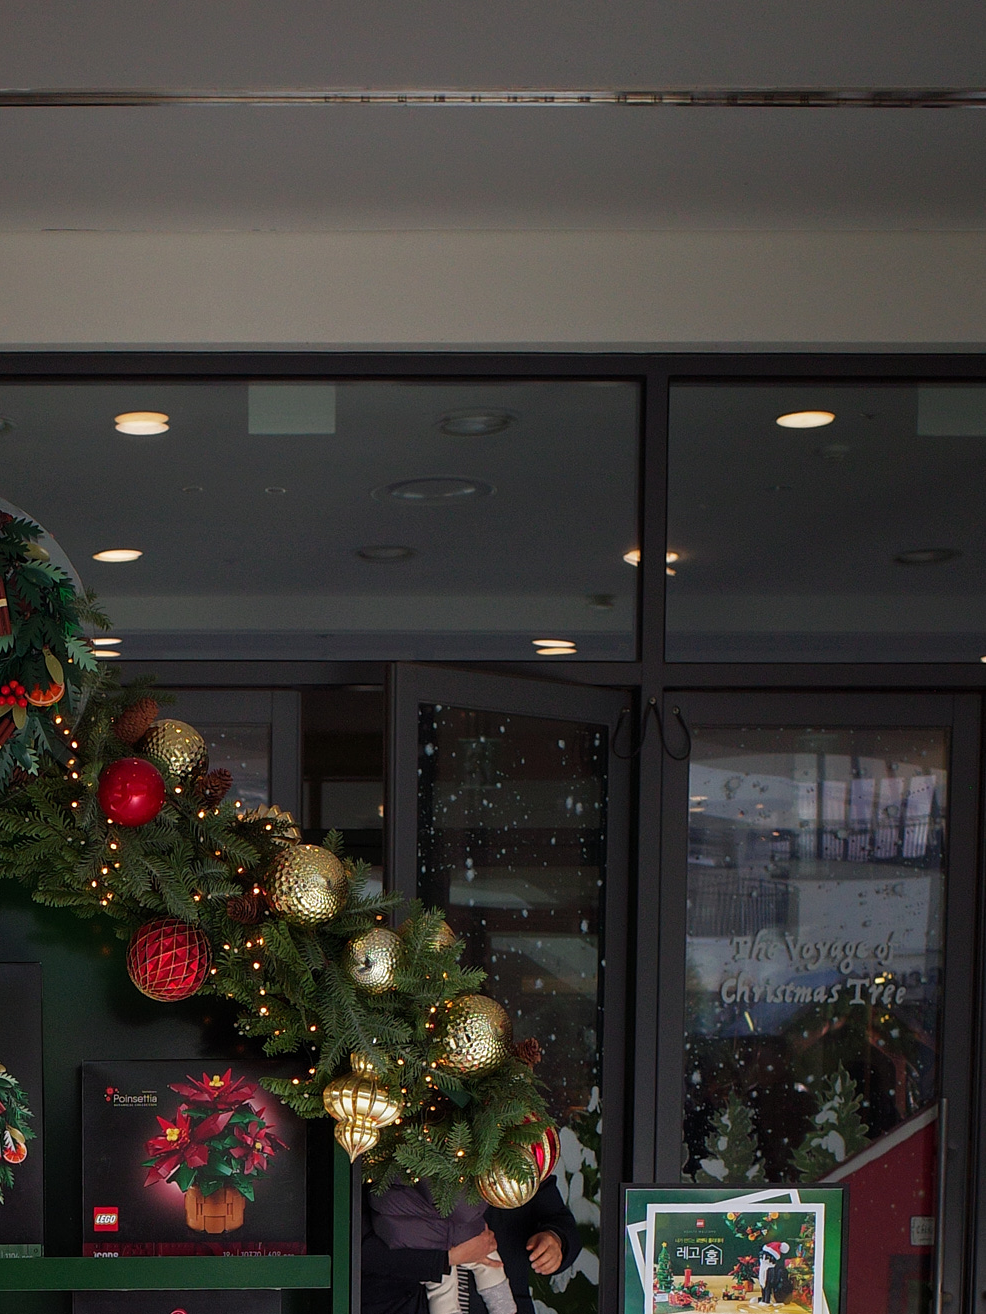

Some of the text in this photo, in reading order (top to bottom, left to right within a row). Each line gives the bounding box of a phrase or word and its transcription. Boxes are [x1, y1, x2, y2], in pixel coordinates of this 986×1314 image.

[730, 928, 895, 975] The Voyage of
[721, 971, 907, 1005] Christmas Tree
[113, 1094, 158, 1103] Poinsettia
[95, 1214, 117, 1224] LEGO
[676, 1246, 719, 1266] 레고 홈
